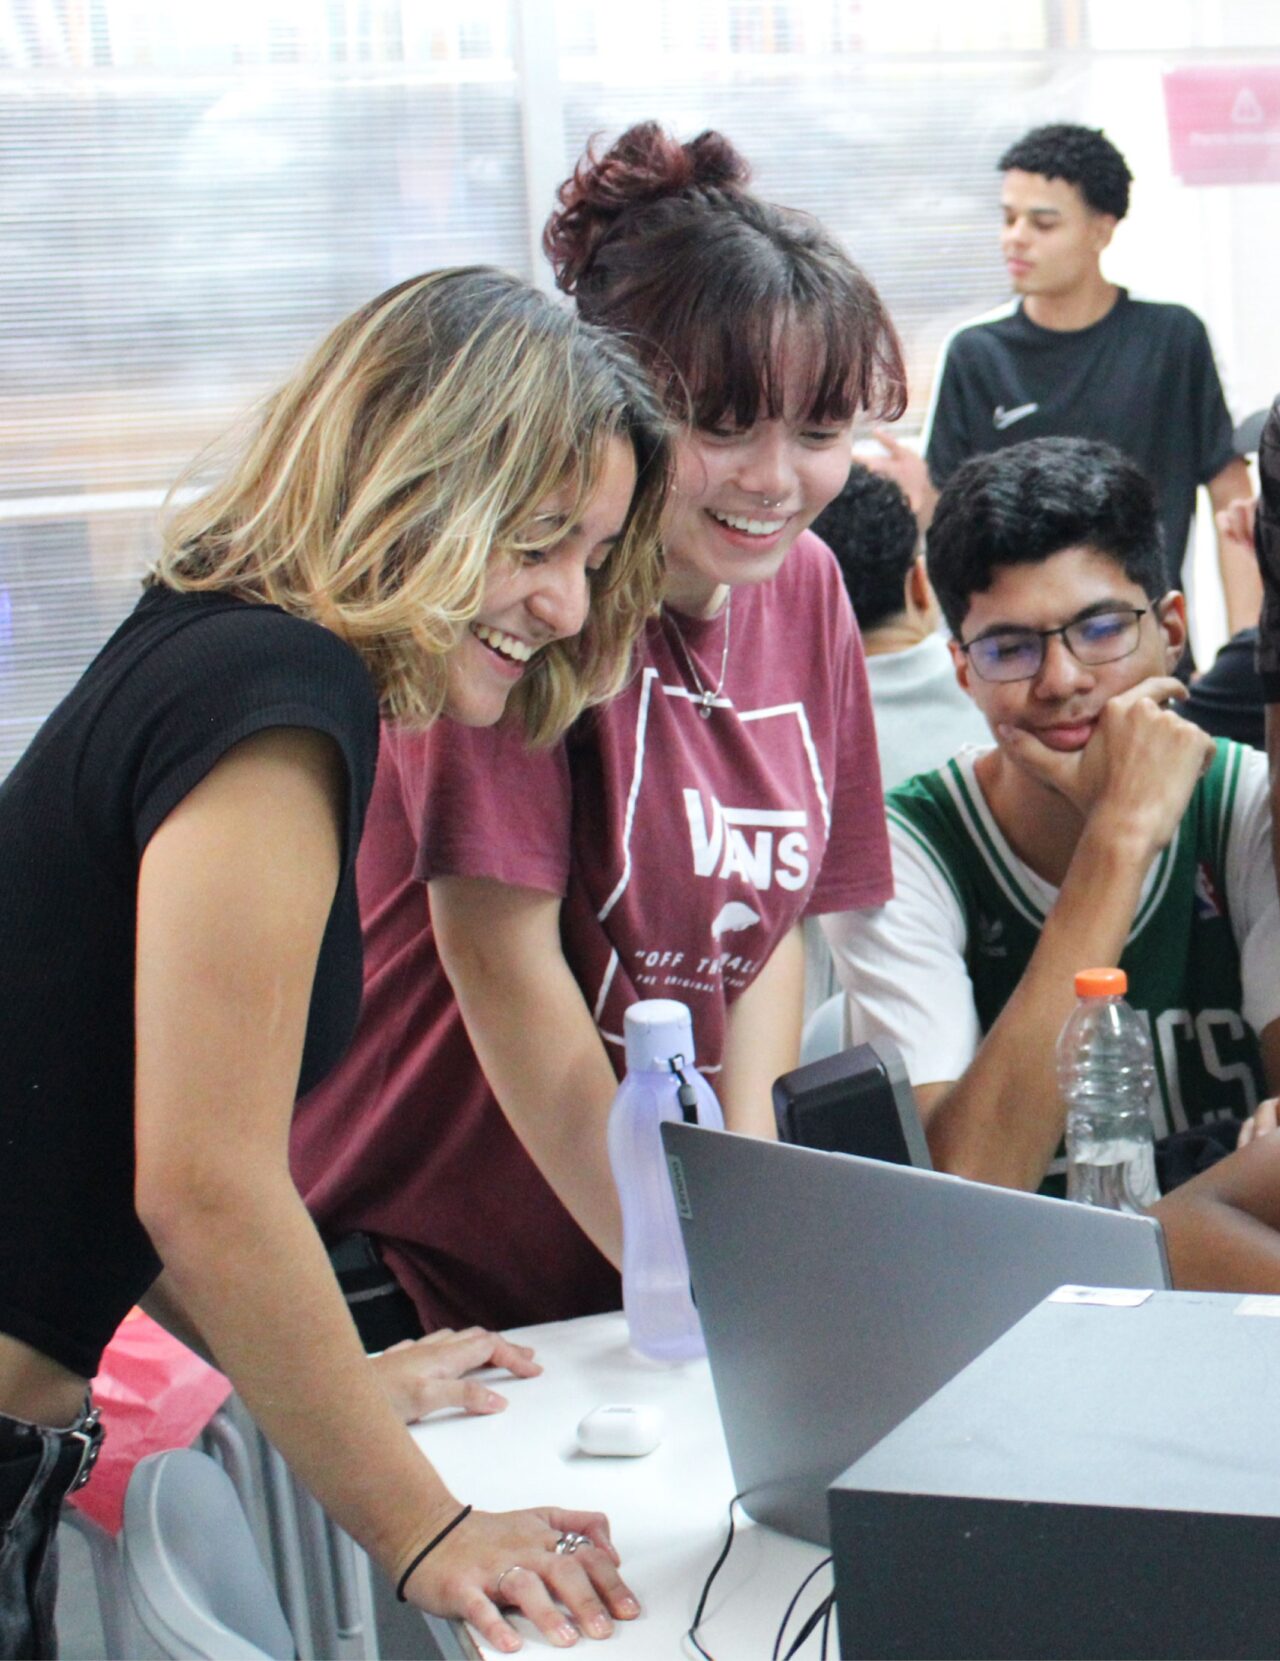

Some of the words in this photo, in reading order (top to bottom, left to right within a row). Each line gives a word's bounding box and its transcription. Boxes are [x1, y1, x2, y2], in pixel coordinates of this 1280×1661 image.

[683, 788, 809, 891] VANS
[635, 950, 685, 968] "OFF
[664, 975, 715, 992] ORIGINAL
[672, 1160, 690, 1214] Lenovo
